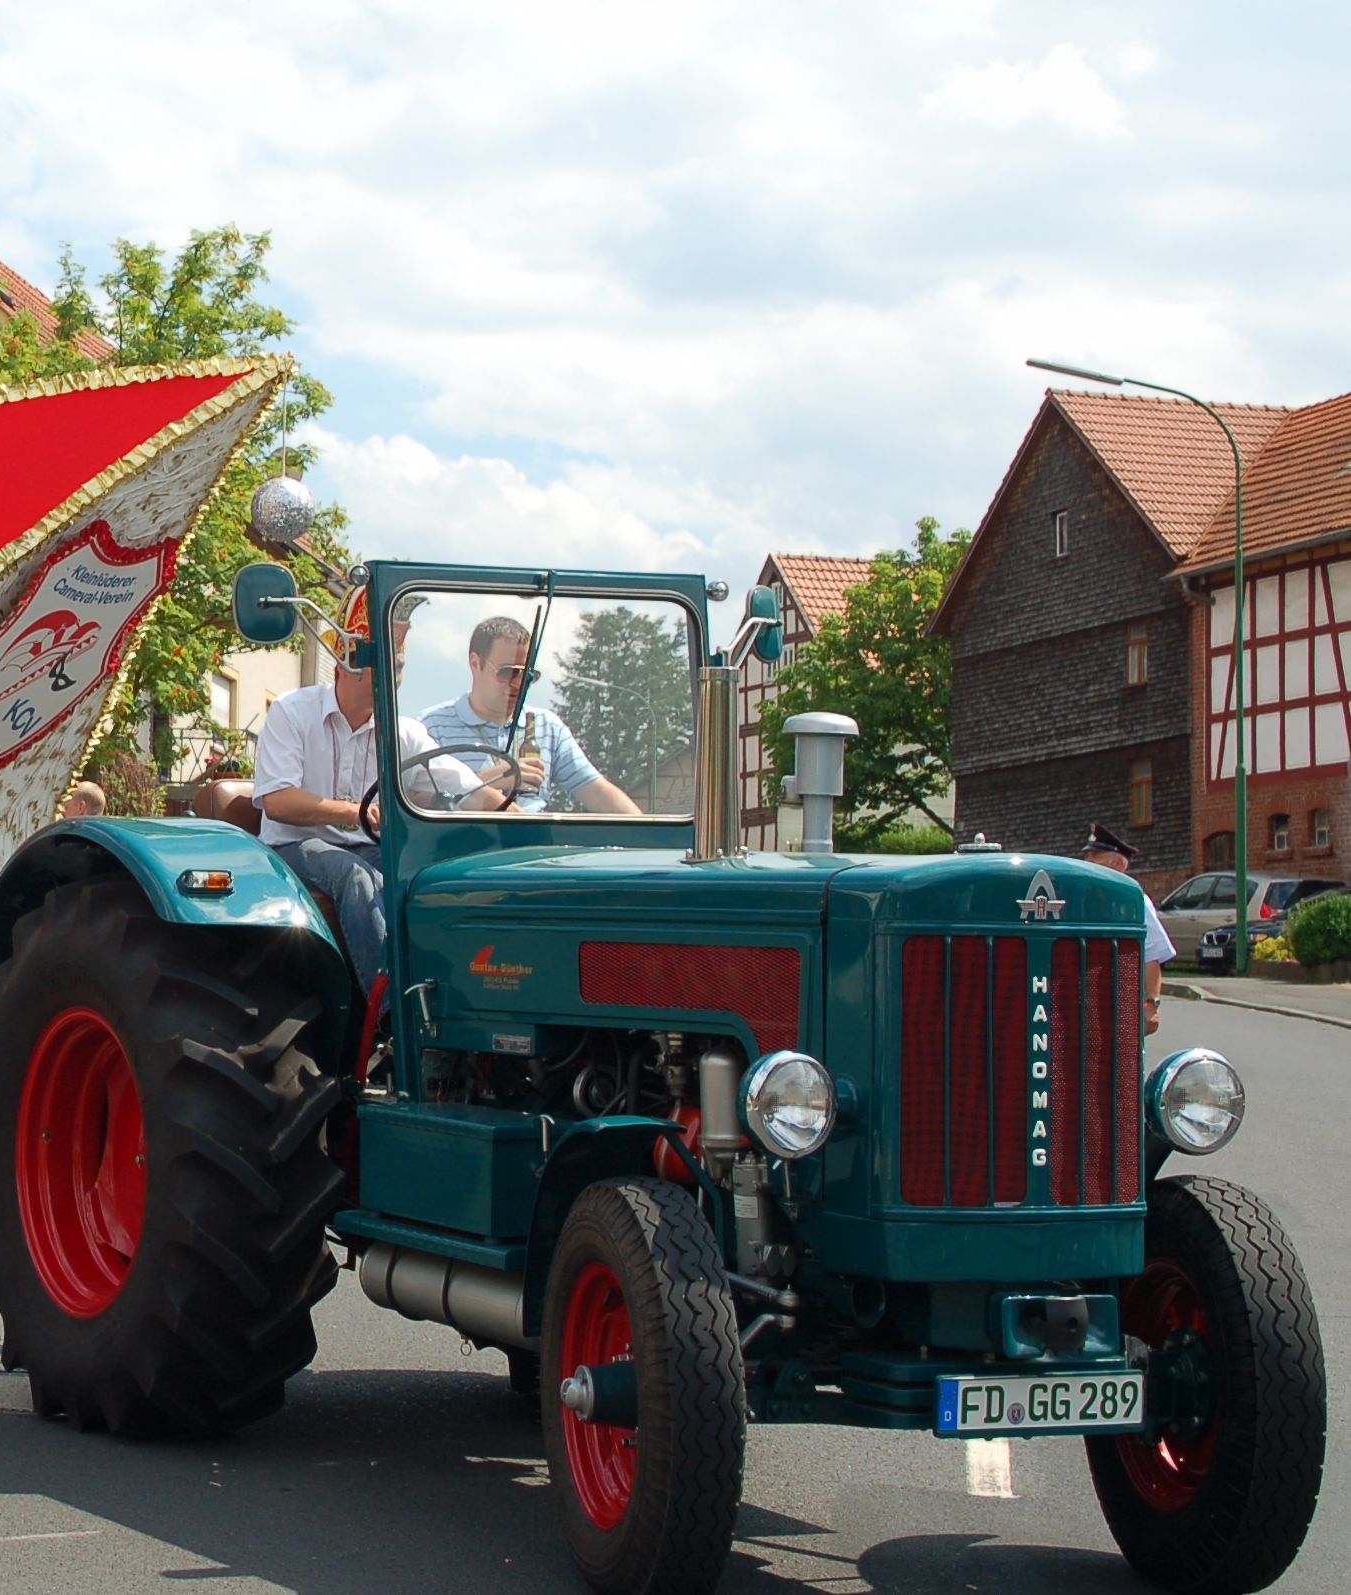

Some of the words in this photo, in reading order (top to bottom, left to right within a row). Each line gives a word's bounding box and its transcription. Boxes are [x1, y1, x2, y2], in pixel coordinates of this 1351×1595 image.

[53, 577, 134, 604] Carneval-Verein
[71, 564, 137, 588] Kleinlüderer
[2, 698, 42, 738] KCV
[1031, 976, 1048, 1167] HANOMAG
[960, 1385, 1005, 1425] FD
[1028, 1382, 1071, 1422] GG
[1079, 1380, 1139, 1420] 289
